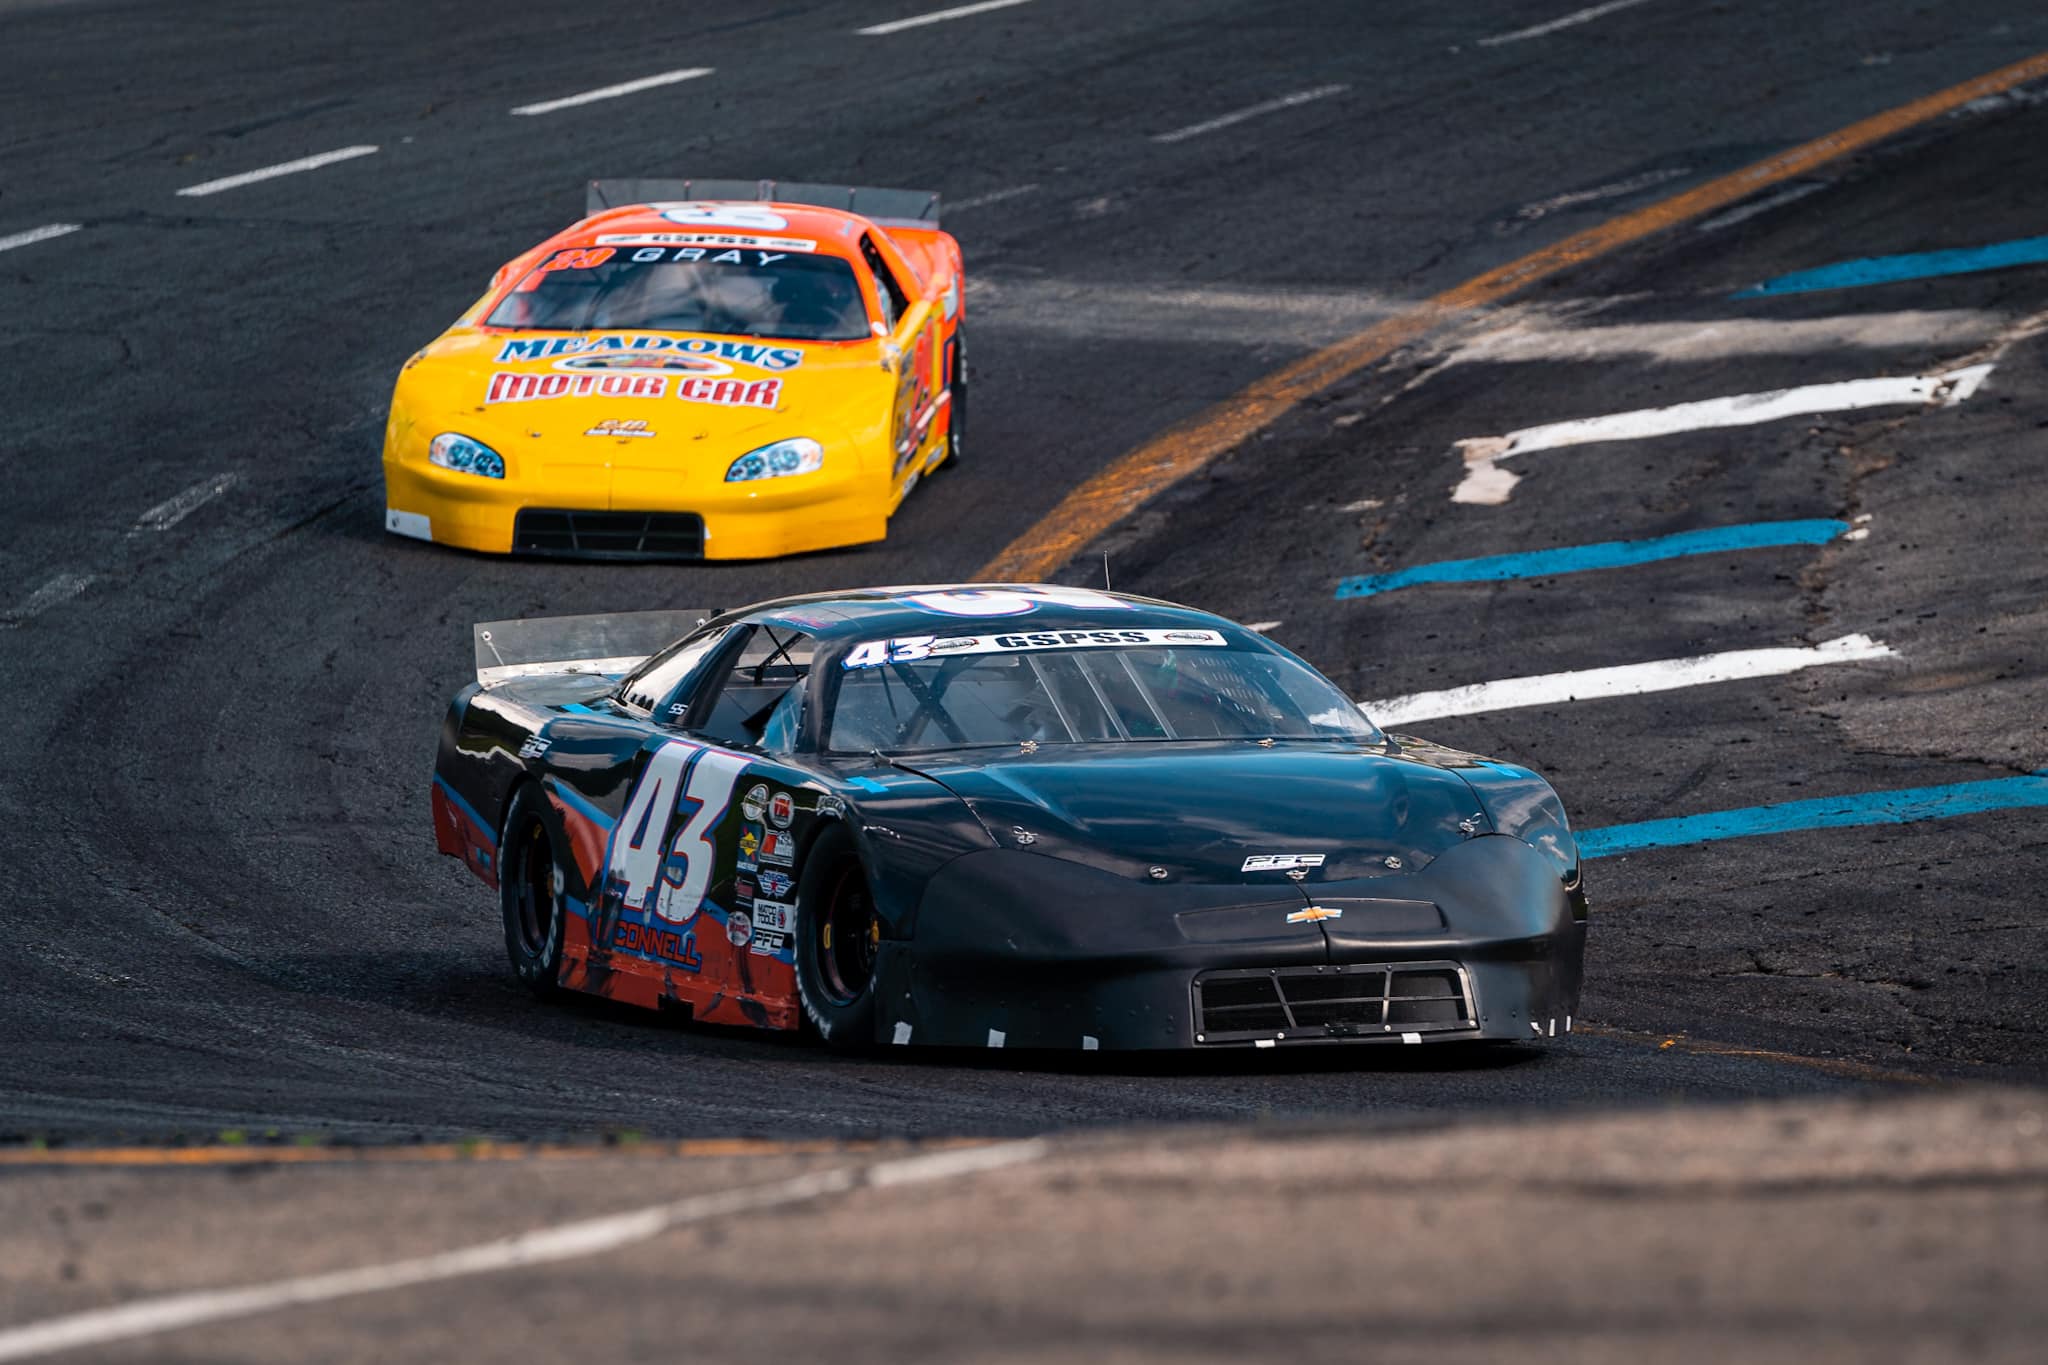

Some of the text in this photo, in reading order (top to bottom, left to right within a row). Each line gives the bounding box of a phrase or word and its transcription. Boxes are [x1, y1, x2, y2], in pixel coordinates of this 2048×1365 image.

[631, 248, 788, 268] GRAY
[494, 336, 804, 369] MEADOWS
[485, 372, 783, 408] MOTOR CAR
[995, 631, 1151, 648] GSPSS
[841, 635, 936, 670] 43
[609, 740, 753, 923] 43
[758, 903, 776, 916] MATCO
[758, 913, 776, 926] TOOLS
[753, 931, 783, 949] PFC
